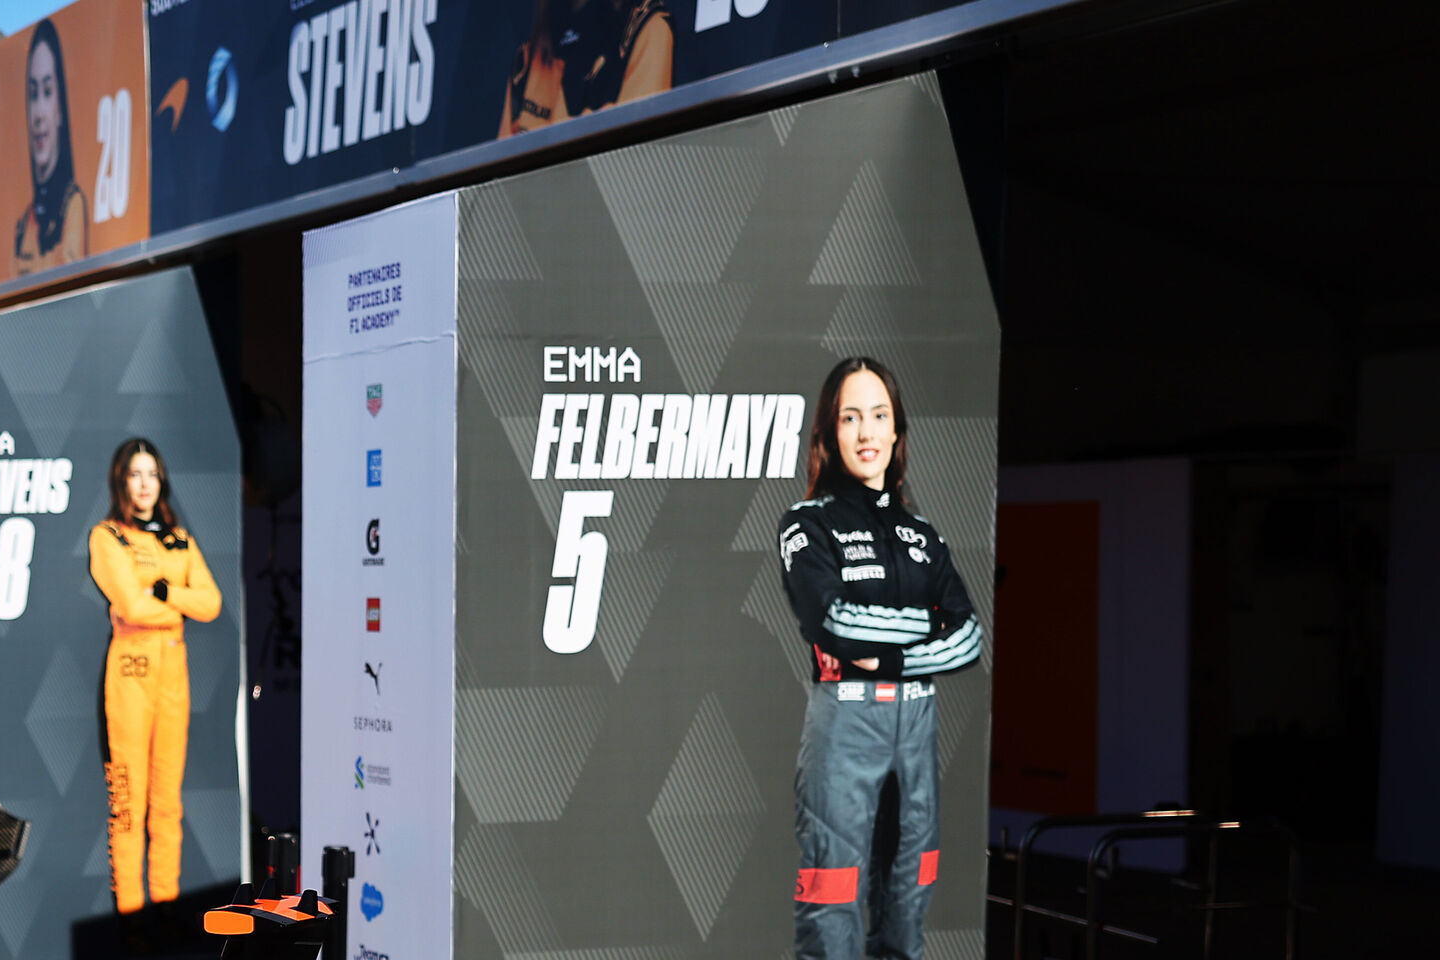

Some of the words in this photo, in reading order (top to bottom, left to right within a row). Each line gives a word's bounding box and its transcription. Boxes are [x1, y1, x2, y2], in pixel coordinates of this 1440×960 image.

[283, 0, 438, 166] STEVENS
[93, 88, 132, 224] 20
[348, 262, 401, 289] PARTENAIRES
[347, 288, 389, 312] OFFICIELS
[392, 284, 403, 302] DE
[349, 317, 359, 334] F1
[543, 345, 642, 383] EMMA
[531, 392, 806, 480] FELBERMAYR
[541, 491, 613, 655] 5
[119, 654, 150, 678] 28
[353, 716, 392, 733] SEPHORA
[360, 944, 379, 960] Team
